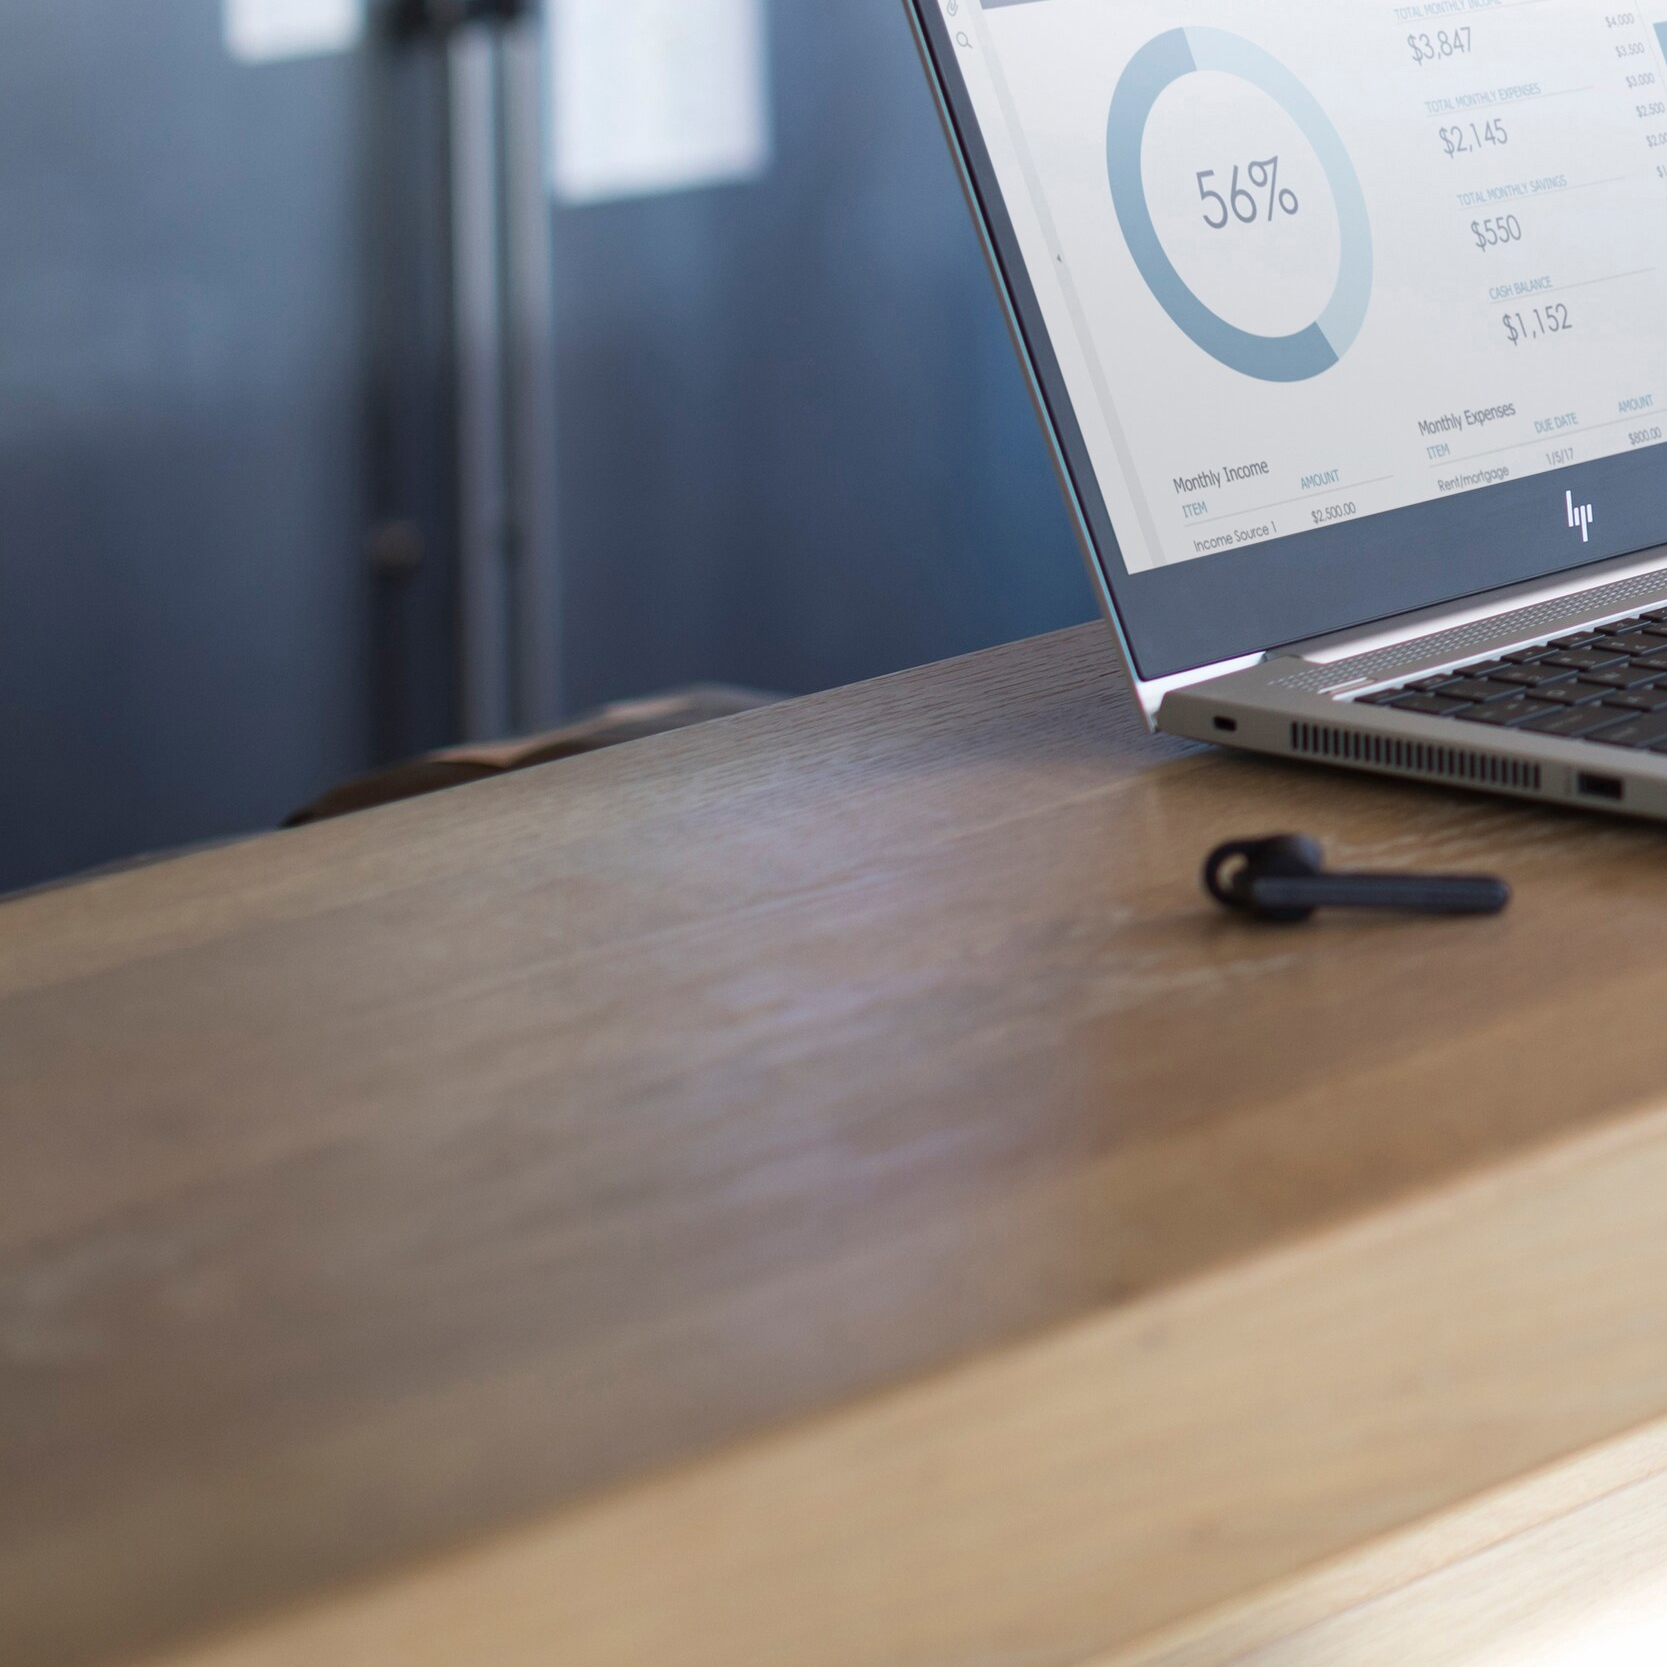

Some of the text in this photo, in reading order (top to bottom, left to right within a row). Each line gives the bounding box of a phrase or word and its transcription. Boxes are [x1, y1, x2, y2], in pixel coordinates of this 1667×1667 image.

[1393, 5, 1424, 22] TOTAL
[1407, 25, 1472, 67] $3,847
[1425, 81, 1542, 114] TOTAL MONTHLY EXPENSES
[1438, 117, 1509, 160] $2,145
[1196, 155, 1299, 229] 56%
[1456, 174, 1568, 208] TOTAL MONTHLY SAVINGS
[1470, 214, 1523, 253] $550
[1488, 275, 1555, 301] CASH BALANCE
[1502, 302, 1574, 347] $1,152
[1418, 401, 1517, 438] Monthly Expenses
[1425, 394, 1655, 460] ITEM DUE DATE AMOUNT
[1173, 459, 1270, 494] Monthly Income
[1437, 426, 1663, 493] Rent/mortgage 1/5/17 $800.00
[1182, 468, 1341, 519] ITEM AMOUNT
[1193, 500, 1357, 554] Income Source 1 $2,500.00
